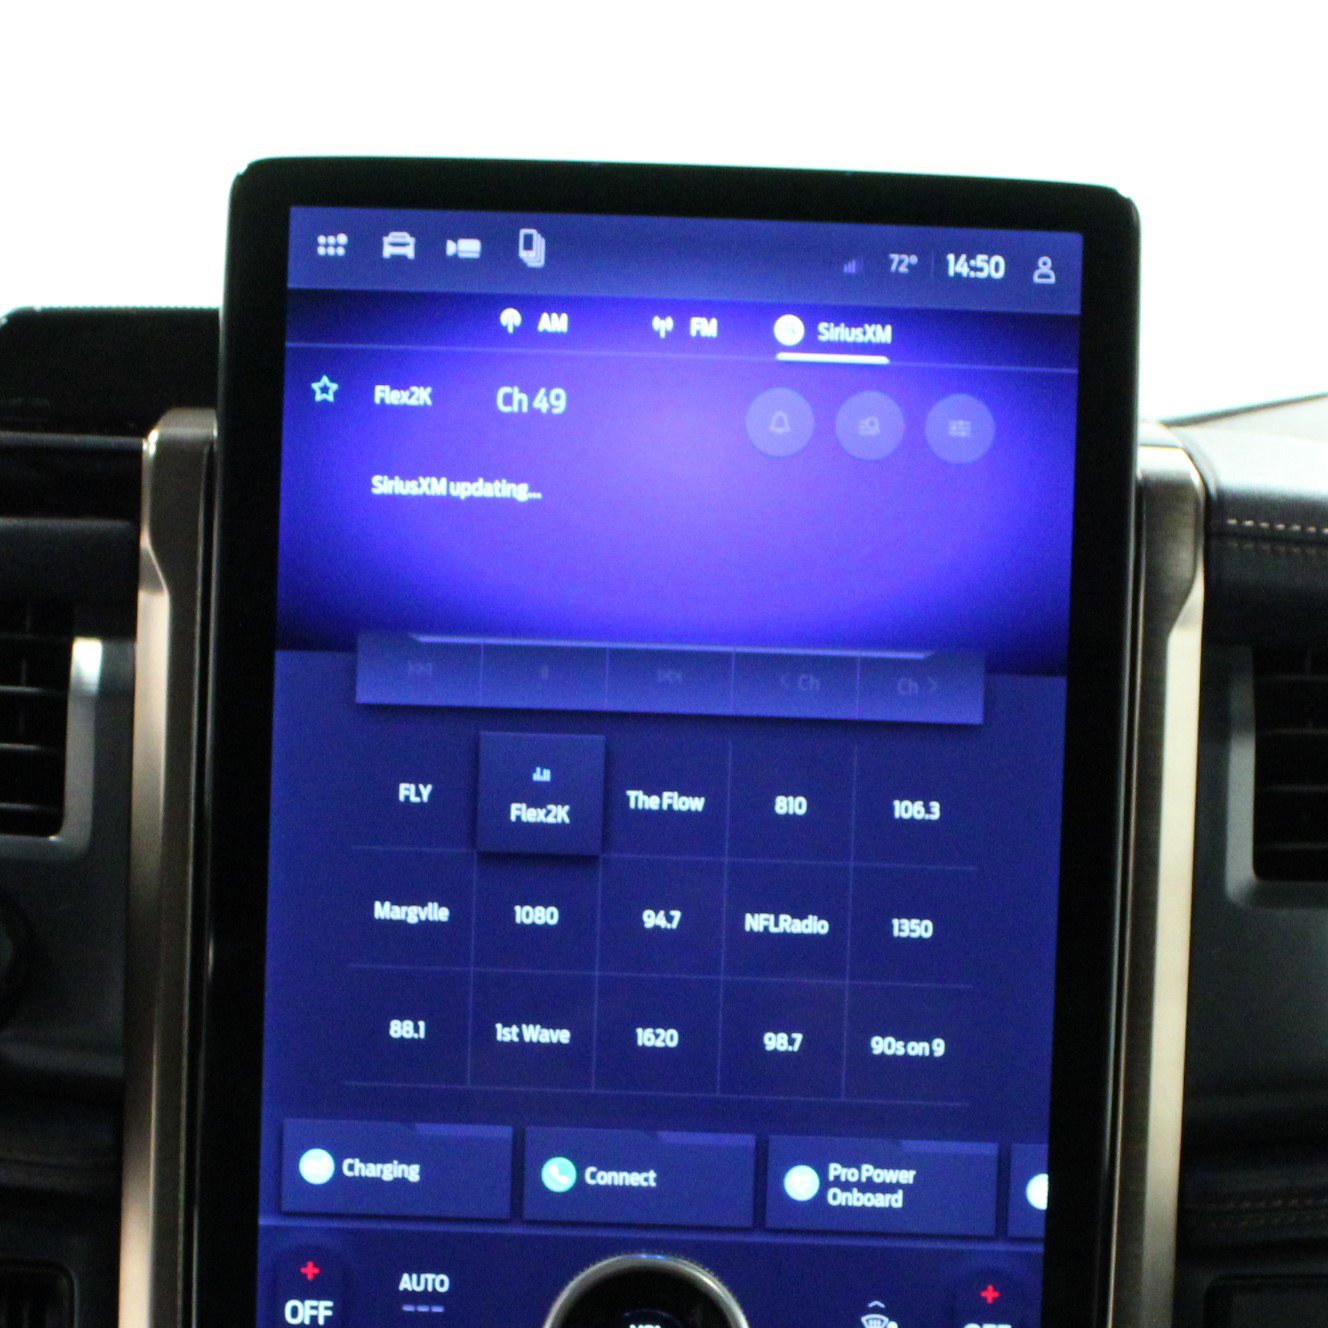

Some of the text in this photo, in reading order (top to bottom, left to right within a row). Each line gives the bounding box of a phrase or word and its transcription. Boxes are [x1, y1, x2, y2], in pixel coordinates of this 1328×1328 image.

[946, 253, 1006, 280] 14:50
[537, 312, 569, 334] AM
[689, 316, 718, 339] FM
[817, 321, 893, 344] SiriusXM
[374, 384, 567, 415] Flex2K Ch 49
[371, 474, 447, 497] SiriusXM
[398, 782, 433, 803] FLY
[626, 789, 706, 812] The Flow
[509, 802, 570, 824] Flex2K
[774, 795, 808, 816] 810
[893, 799, 941, 821] 106.3
[514, 905, 560, 926] 1080
[642, 909, 682, 930] 94.7
[891, 918, 934, 939] 1350
[389, 1019, 426, 1039] 88.1
[495, 1022, 571, 1044] 1st Wave
[635, 1027, 679, 1048] 1620
[763, 1031, 804, 1052] 98.7
[870, 1035, 946, 1058] 90s on 9
[341, 1157, 421, 1183] Charging
[584, 1166, 657, 1188] Connect
[828, 1162, 917, 1185] Pro Power
[826, 1187, 904, 1209] Onboard
[398, 1272, 450, 1293] AUTO
[284, 1299, 334, 1326] OFF
